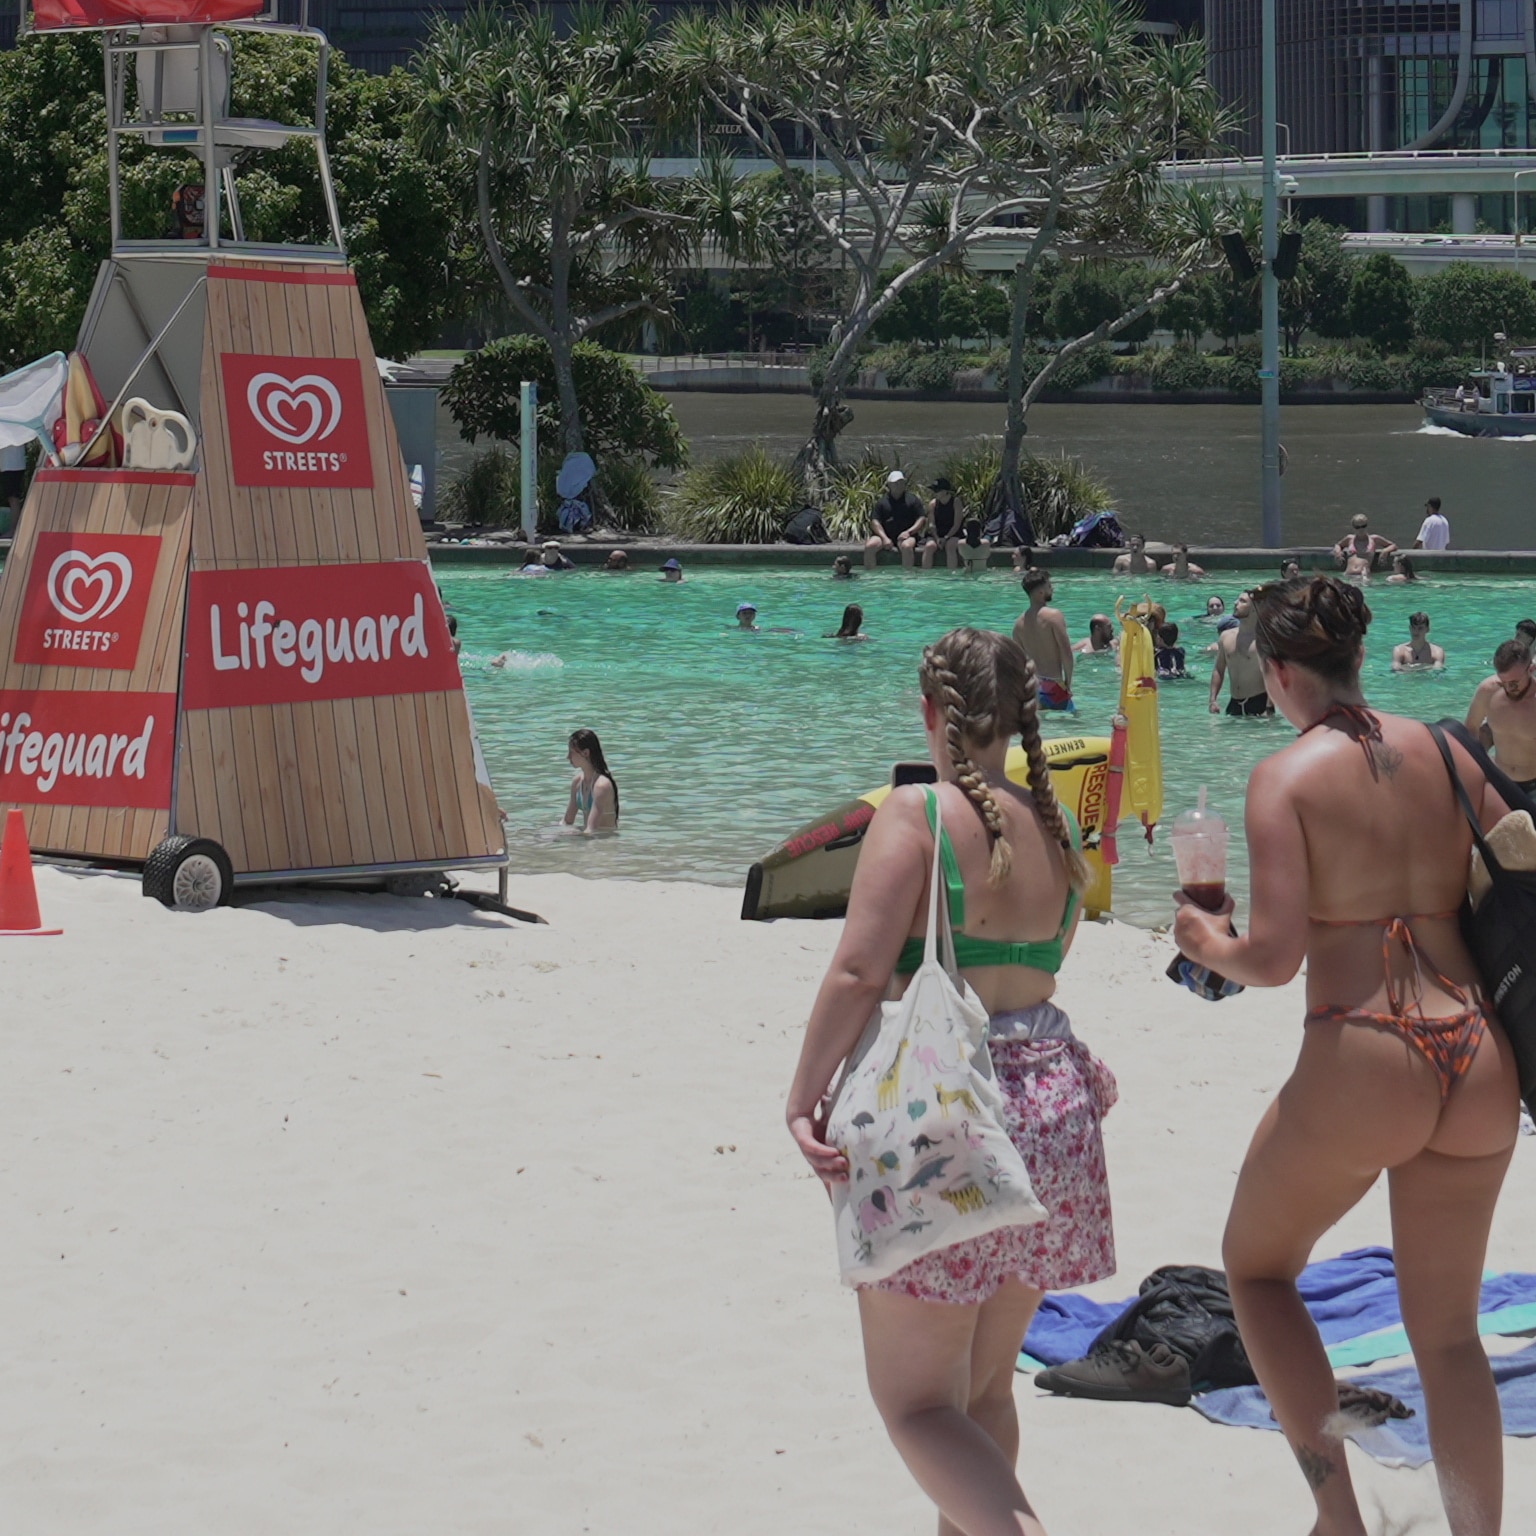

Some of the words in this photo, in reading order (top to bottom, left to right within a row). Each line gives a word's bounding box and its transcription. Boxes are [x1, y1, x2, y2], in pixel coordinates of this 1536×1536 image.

[210, 592, 428, 684] Lifeguard
[1084, 763, 1108, 826] RESCUE
[785, 821, 840, 858] RESCUE
